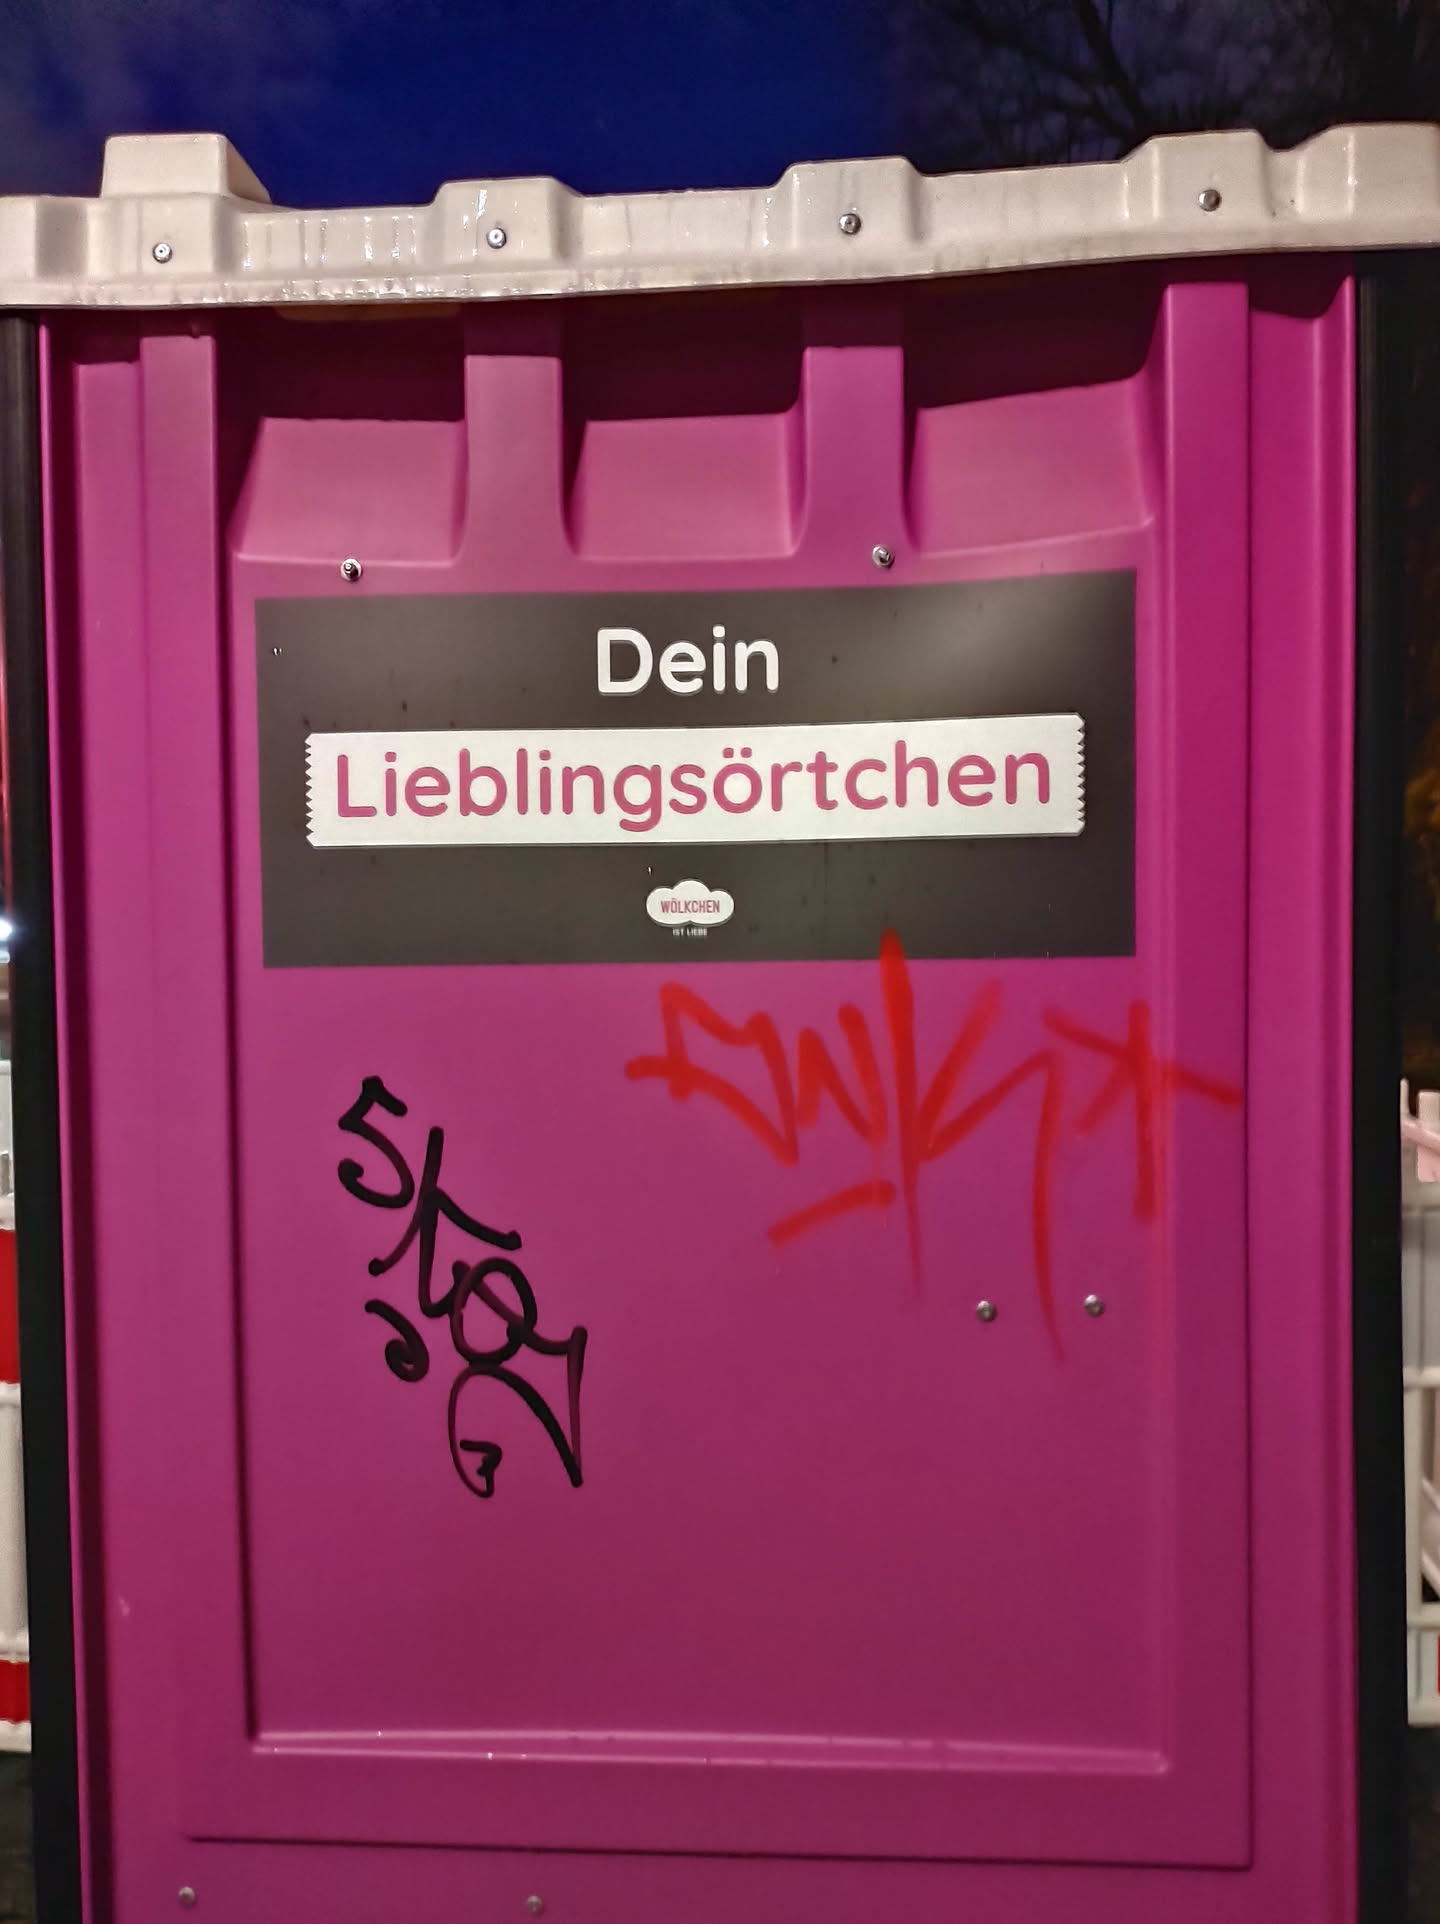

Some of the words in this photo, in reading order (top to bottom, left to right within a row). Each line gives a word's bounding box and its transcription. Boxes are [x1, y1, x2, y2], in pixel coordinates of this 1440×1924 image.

[596, 624, 780, 696] Dein
[335, 739, 1052, 832] Lieblingsörtchen
[660, 898, 720, 914] WÖLKCHEN
